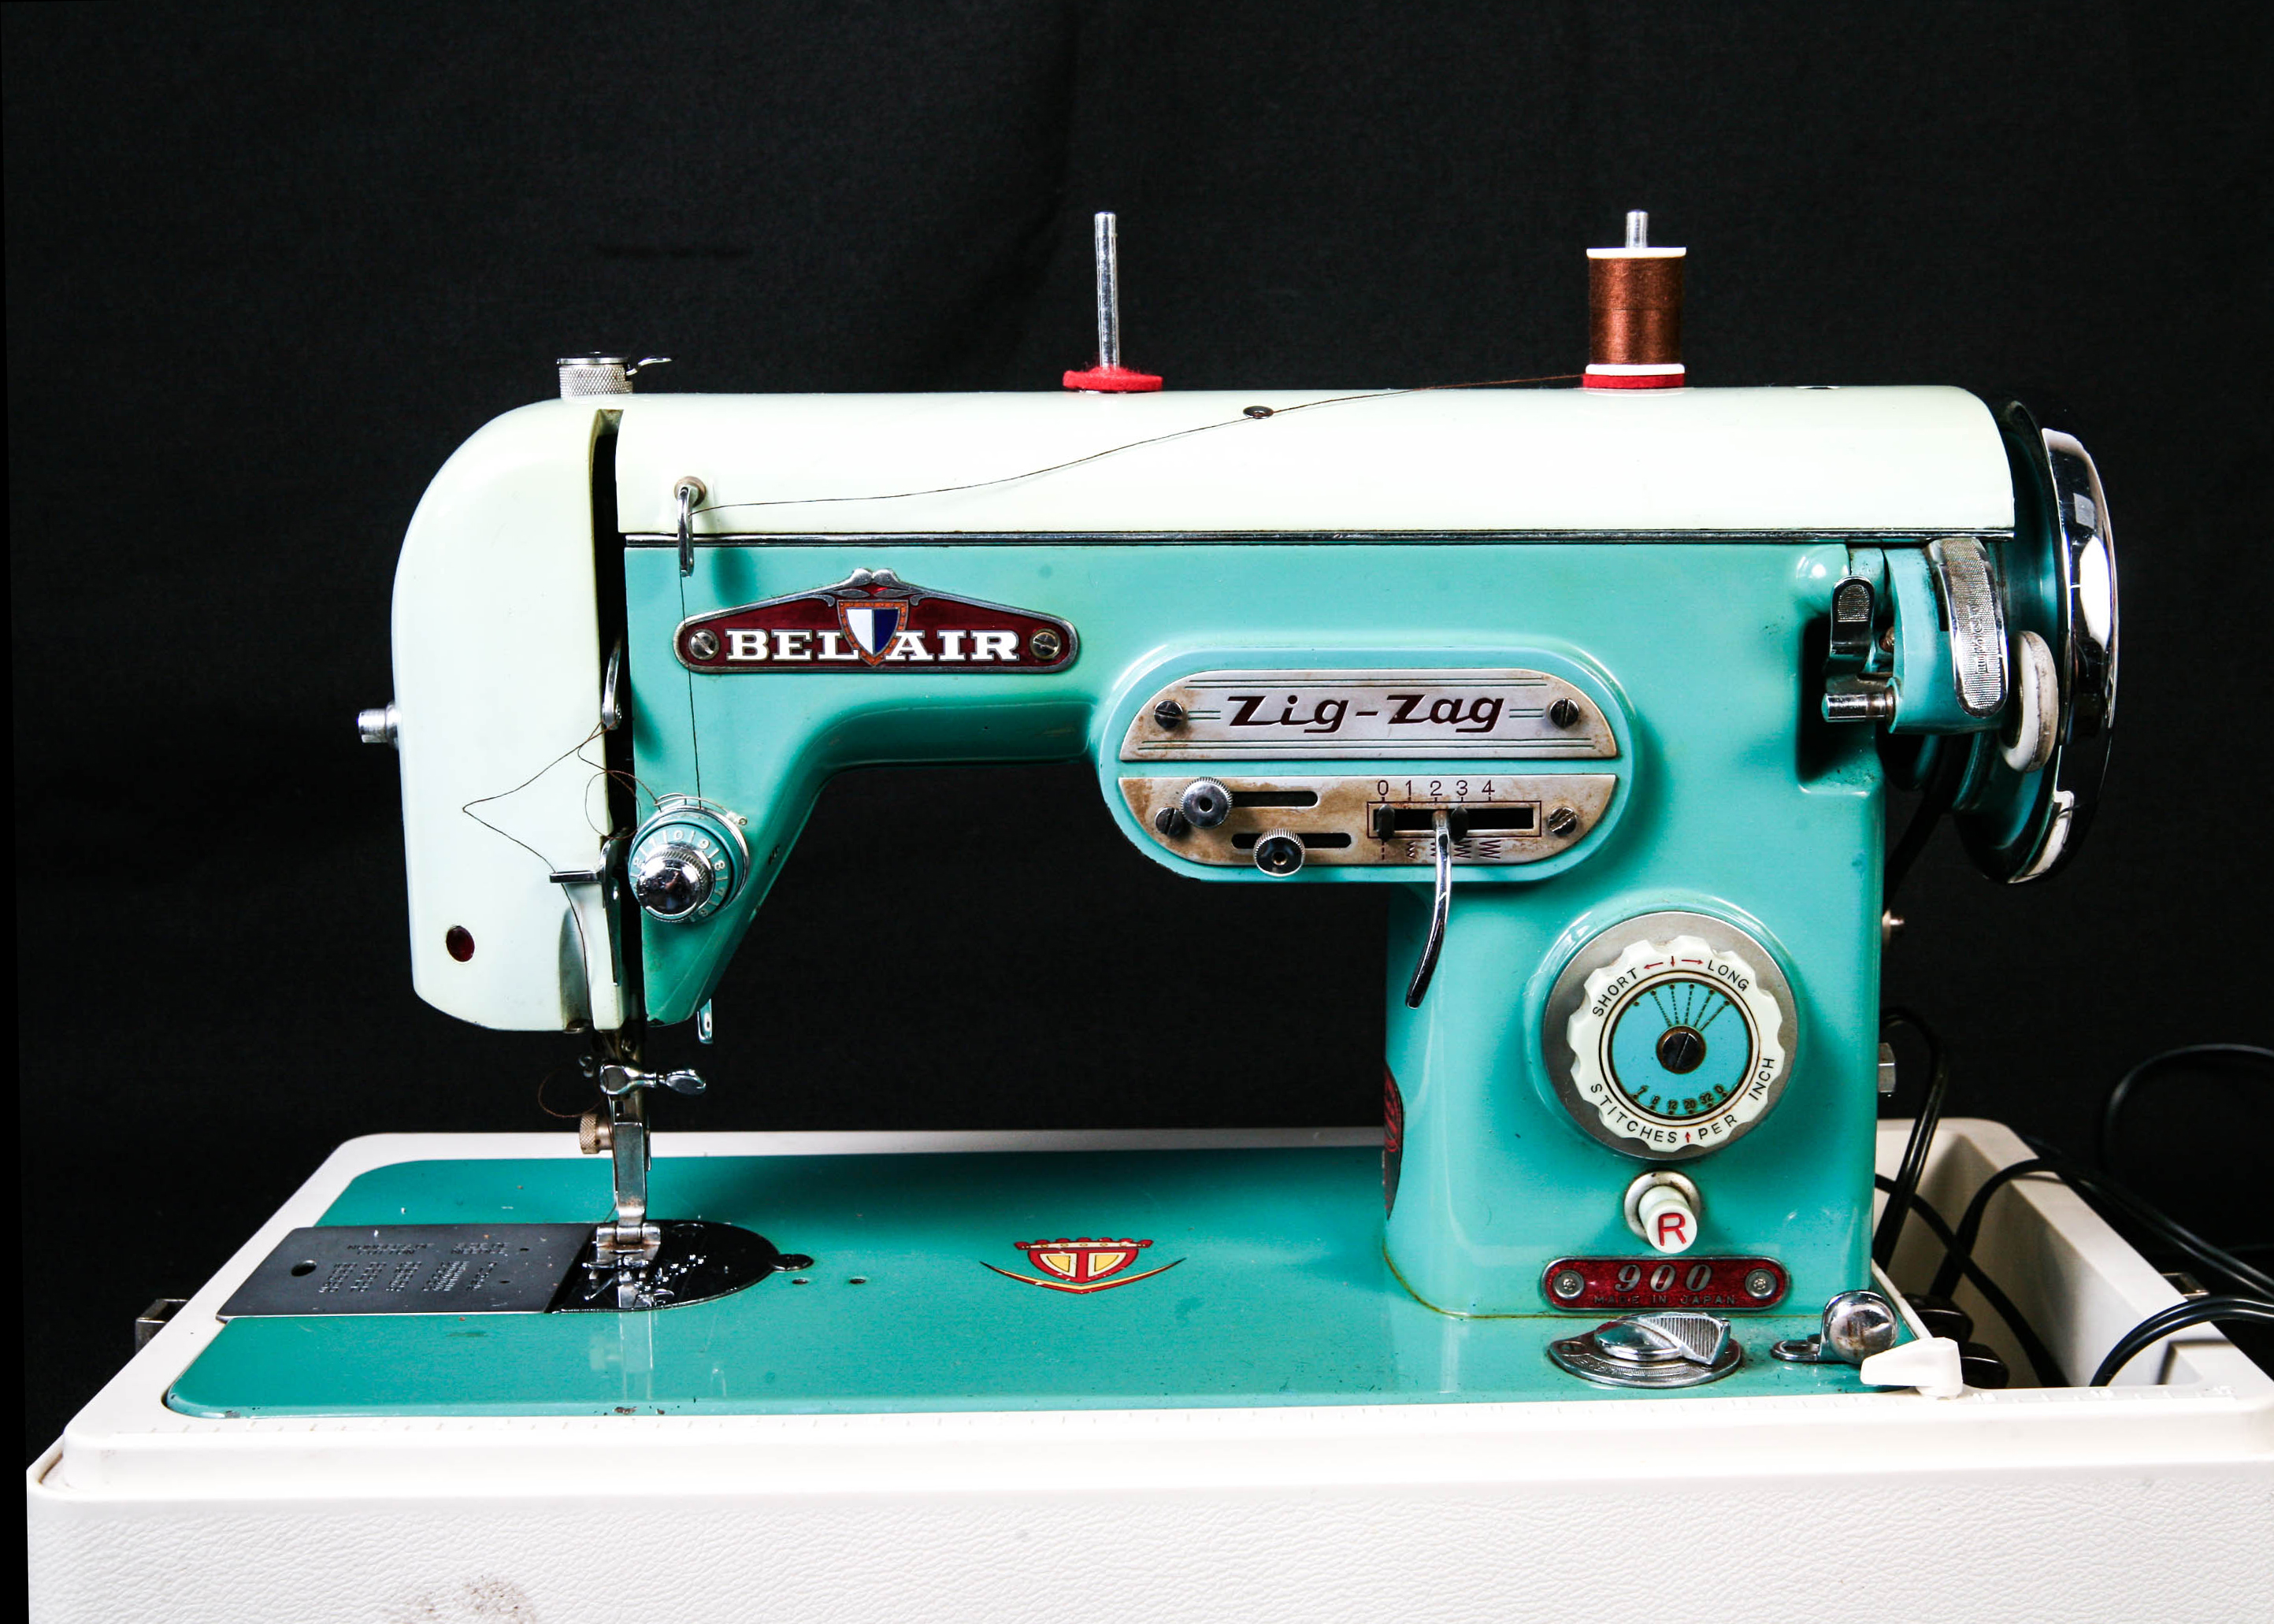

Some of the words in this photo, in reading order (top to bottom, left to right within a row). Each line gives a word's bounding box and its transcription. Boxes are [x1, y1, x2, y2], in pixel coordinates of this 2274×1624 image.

[725, 629, 859, 662] BEL
[884, 629, 1020, 662] AIR
[1226, 694, 1505, 733] Zig-Zag
[1378, 779, 1389, 796] 0
[1405, 779, 1412, 796] 1
[1430, 780, 1442, 796] 2
[1456, 779, 1468, 796] 3
[1482, 779, 1495, 796] 4
[699, 840, 710, 850] 9
[714, 859, 725, 871] 8
[1592, 967, 1639, 1017] SHORT
[1707, 959, 1750, 992] LONG
[1590, 1082, 1678, 1144] STITCHES
[1697, 1113, 1738, 1140] PER
[1748, 1057, 1775, 1101] INCH
[1683, 1098, 1697, 1109] 20
[1657, 1212, 1687, 1247] R
[1614, 1264, 1713, 1292] 900
[1593, 1296, 1639, 1305] MADE
[1653, 1296, 1667, 1304] IN
[1681, 1296, 1737, 1305] JAPAN
